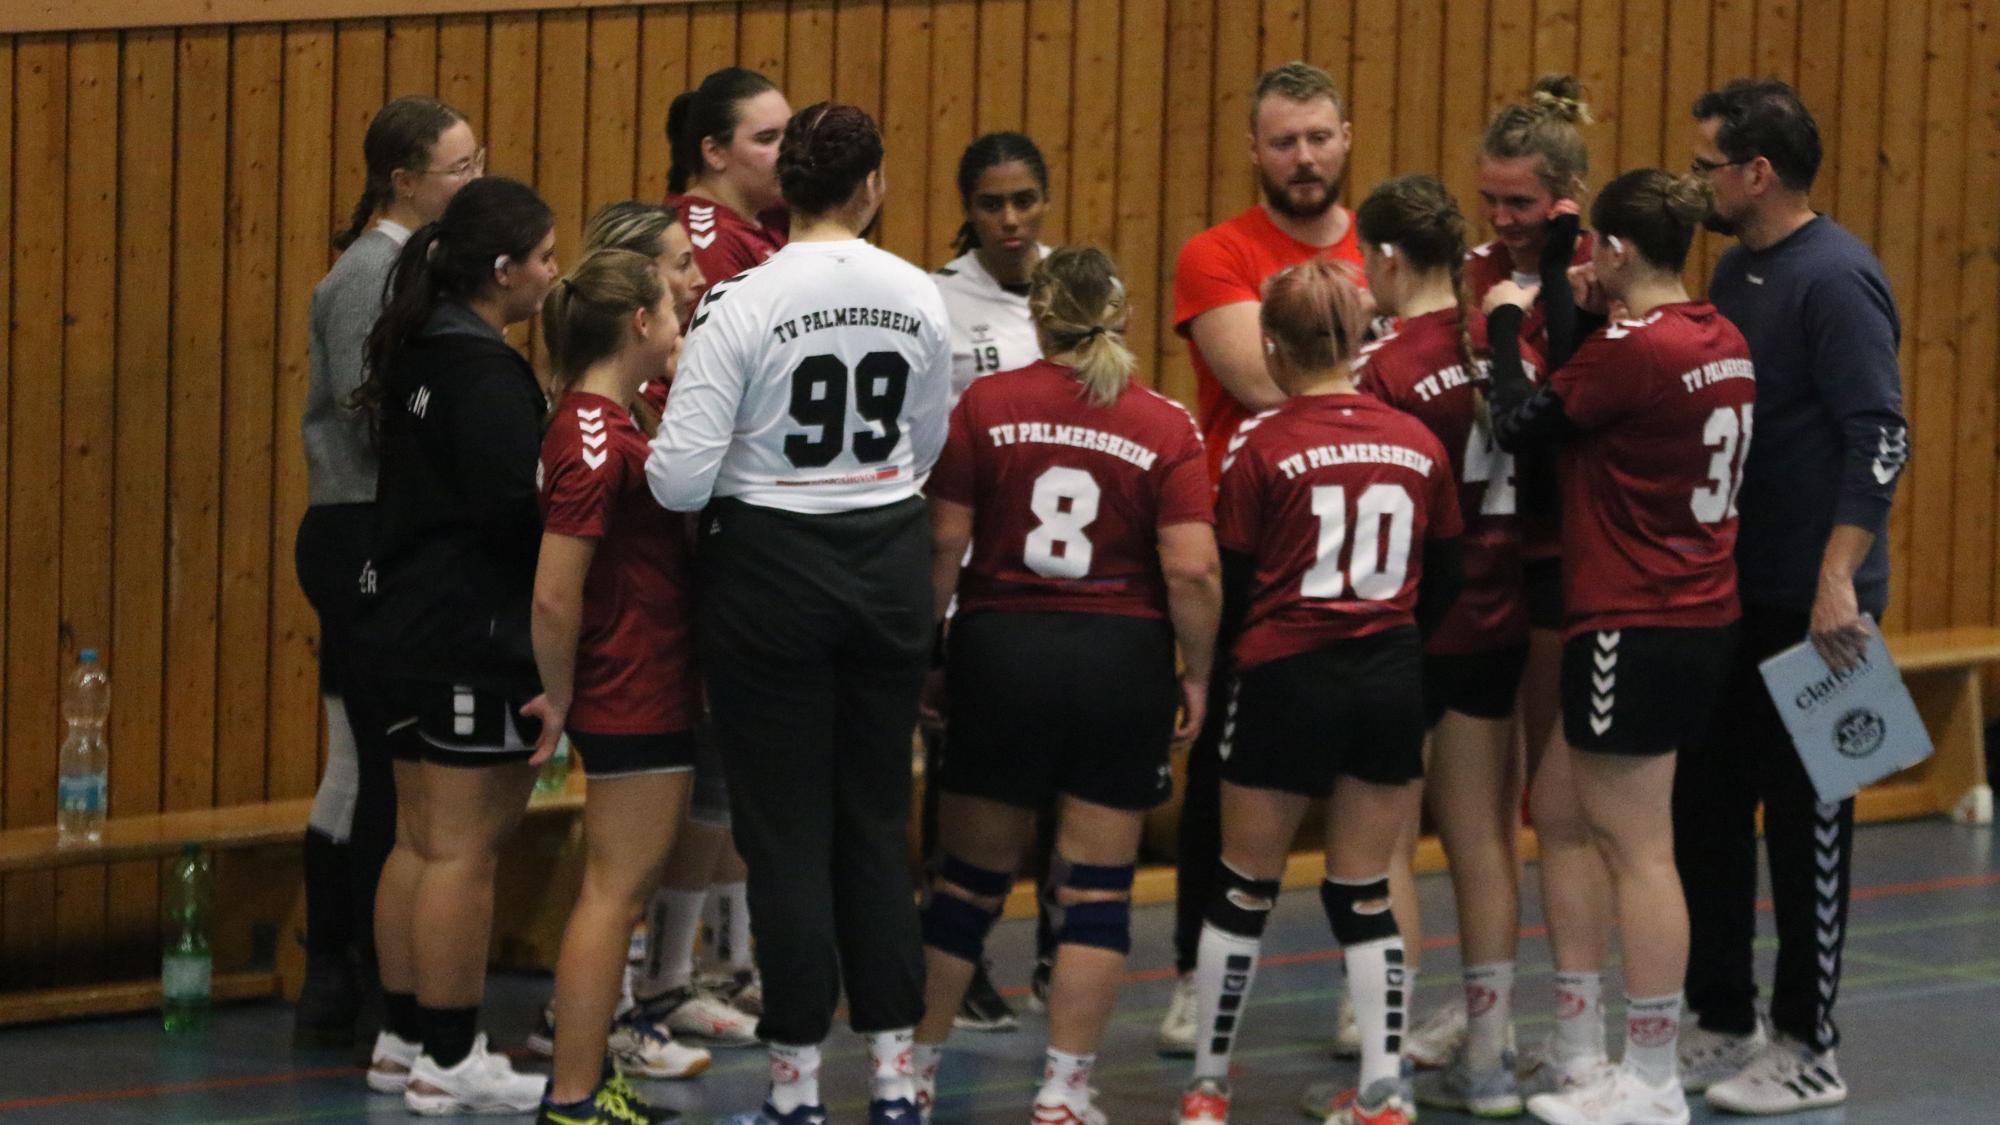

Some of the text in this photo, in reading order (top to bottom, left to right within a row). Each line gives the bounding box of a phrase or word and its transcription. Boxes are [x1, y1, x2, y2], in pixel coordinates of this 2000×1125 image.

[773, 308, 922, 343] TV PALMERSHEIM
[974, 346, 1000, 372] 19
[1413, 374, 1441, 402] TV
[1681, 368, 1703, 393] TV
[783, 351, 910, 468] 99
[988, 422, 1158, 471] TV PALMERSHEIM
[1278, 443, 1434, 480] TV PALMERSHEIM
[1023, 466, 1101, 579] 8
[1300, 484, 1415, 600] 10
